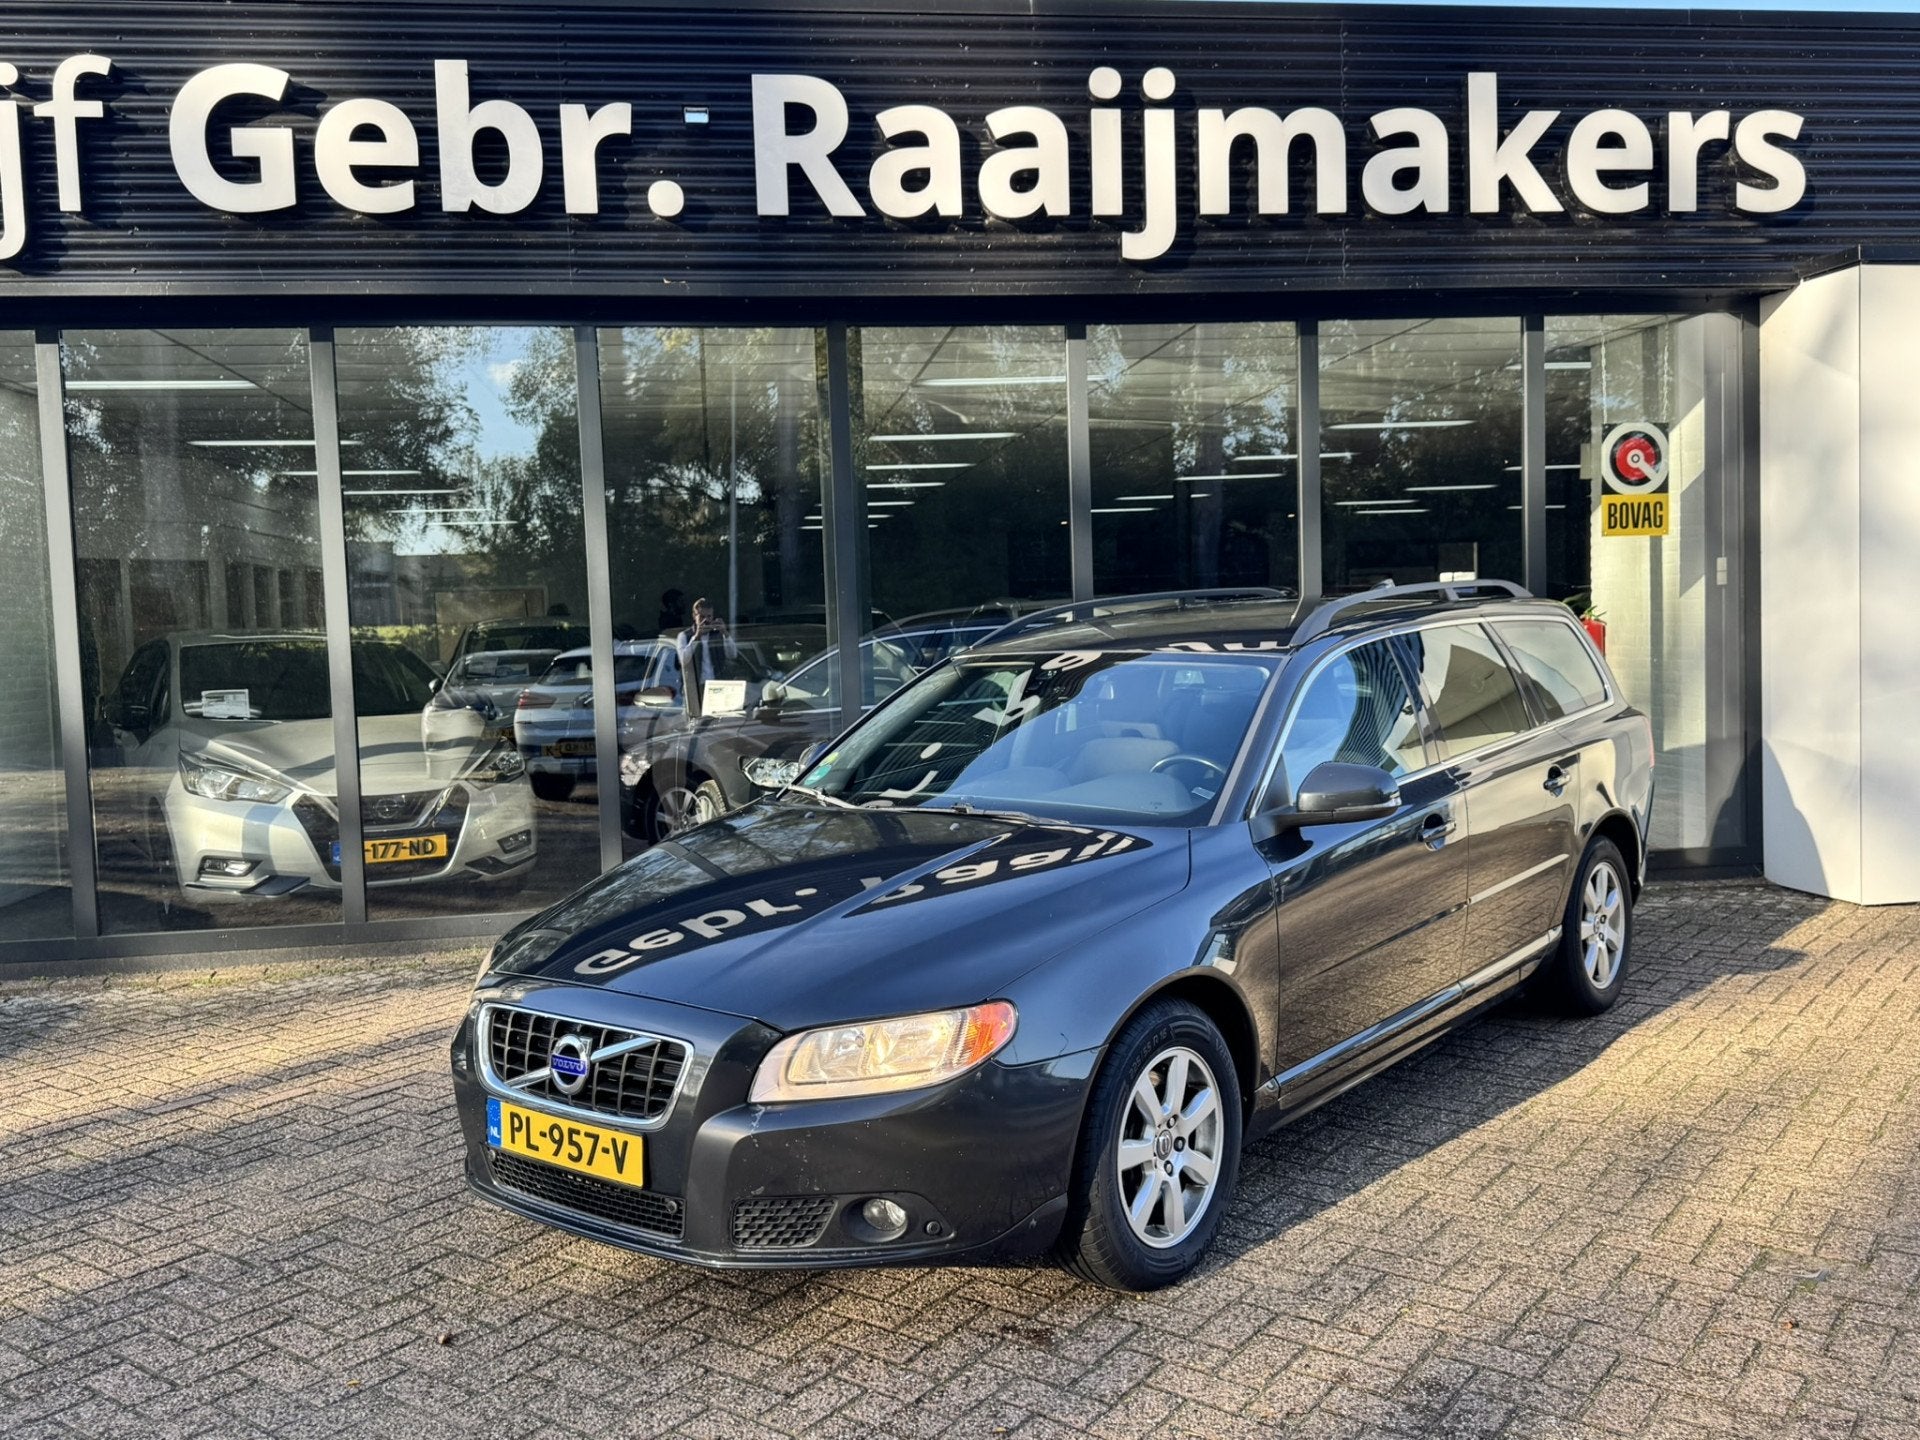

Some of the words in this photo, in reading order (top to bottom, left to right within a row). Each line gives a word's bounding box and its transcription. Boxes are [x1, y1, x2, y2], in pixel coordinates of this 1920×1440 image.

[170, 60, 685, 216] Gebr.
[752, 67, 1806, 259] Raaijmakers
[1607, 501, 1664, 530] BOVAG
[365, 838, 438, 859] -177-ND
[552, 1057, 585, 1072] VOLVO
[490, 1125, 500, 1138] NL
[509, 1111, 629, 1174] PL-957-V
